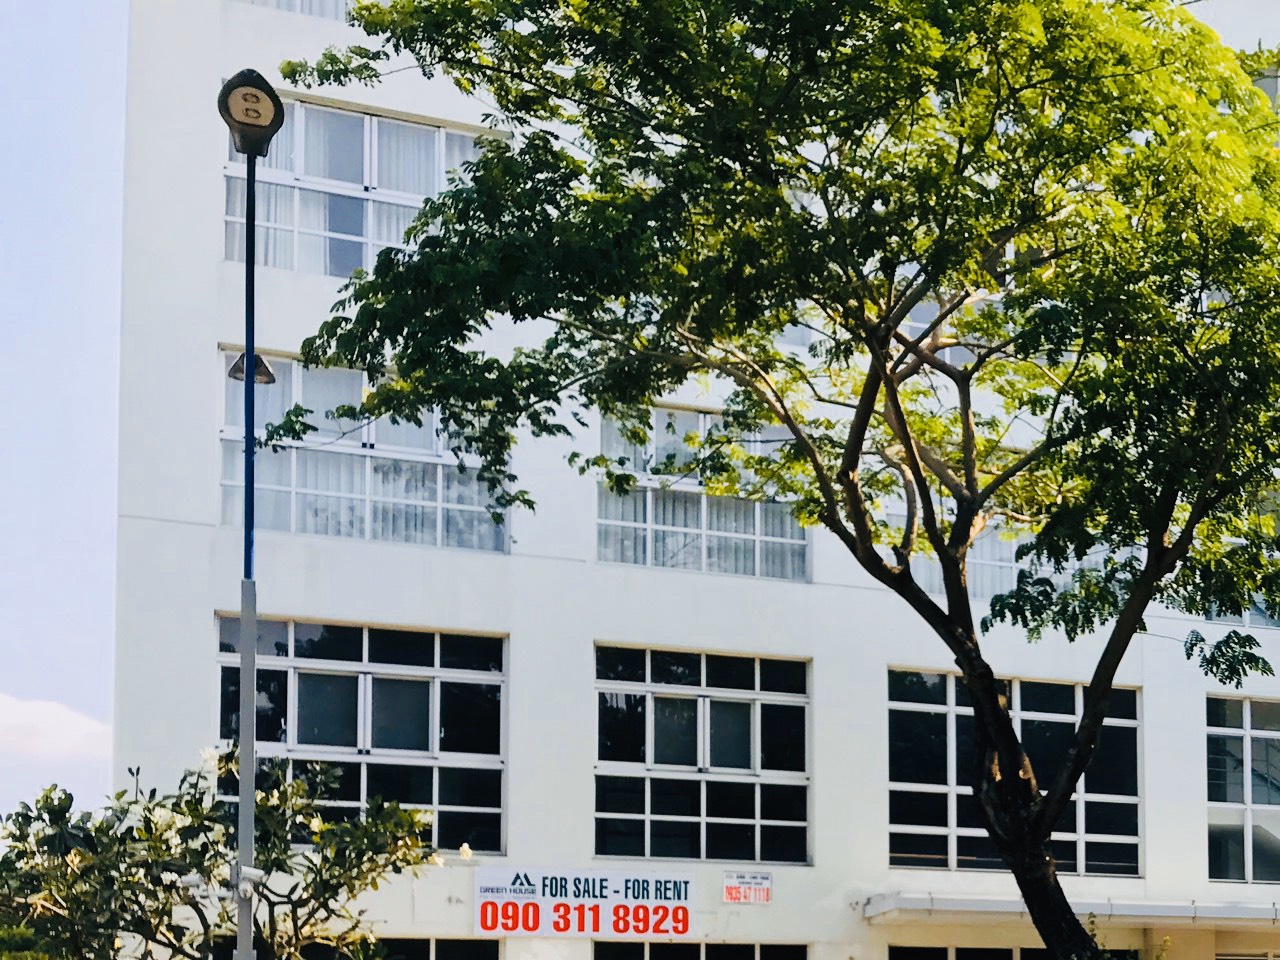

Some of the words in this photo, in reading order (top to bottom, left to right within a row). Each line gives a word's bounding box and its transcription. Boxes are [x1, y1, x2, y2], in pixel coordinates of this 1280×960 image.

[541, 876, 569, 899] FOR
[573, 877, 609, 899] SALE
[624, 878, 651, 900] FOR
[654, 879, 691, 901] RENT
[480, 900, 541, 932] 090
[552, 902, 600, 933] 311
[612, 904, 690, 935] 8929
